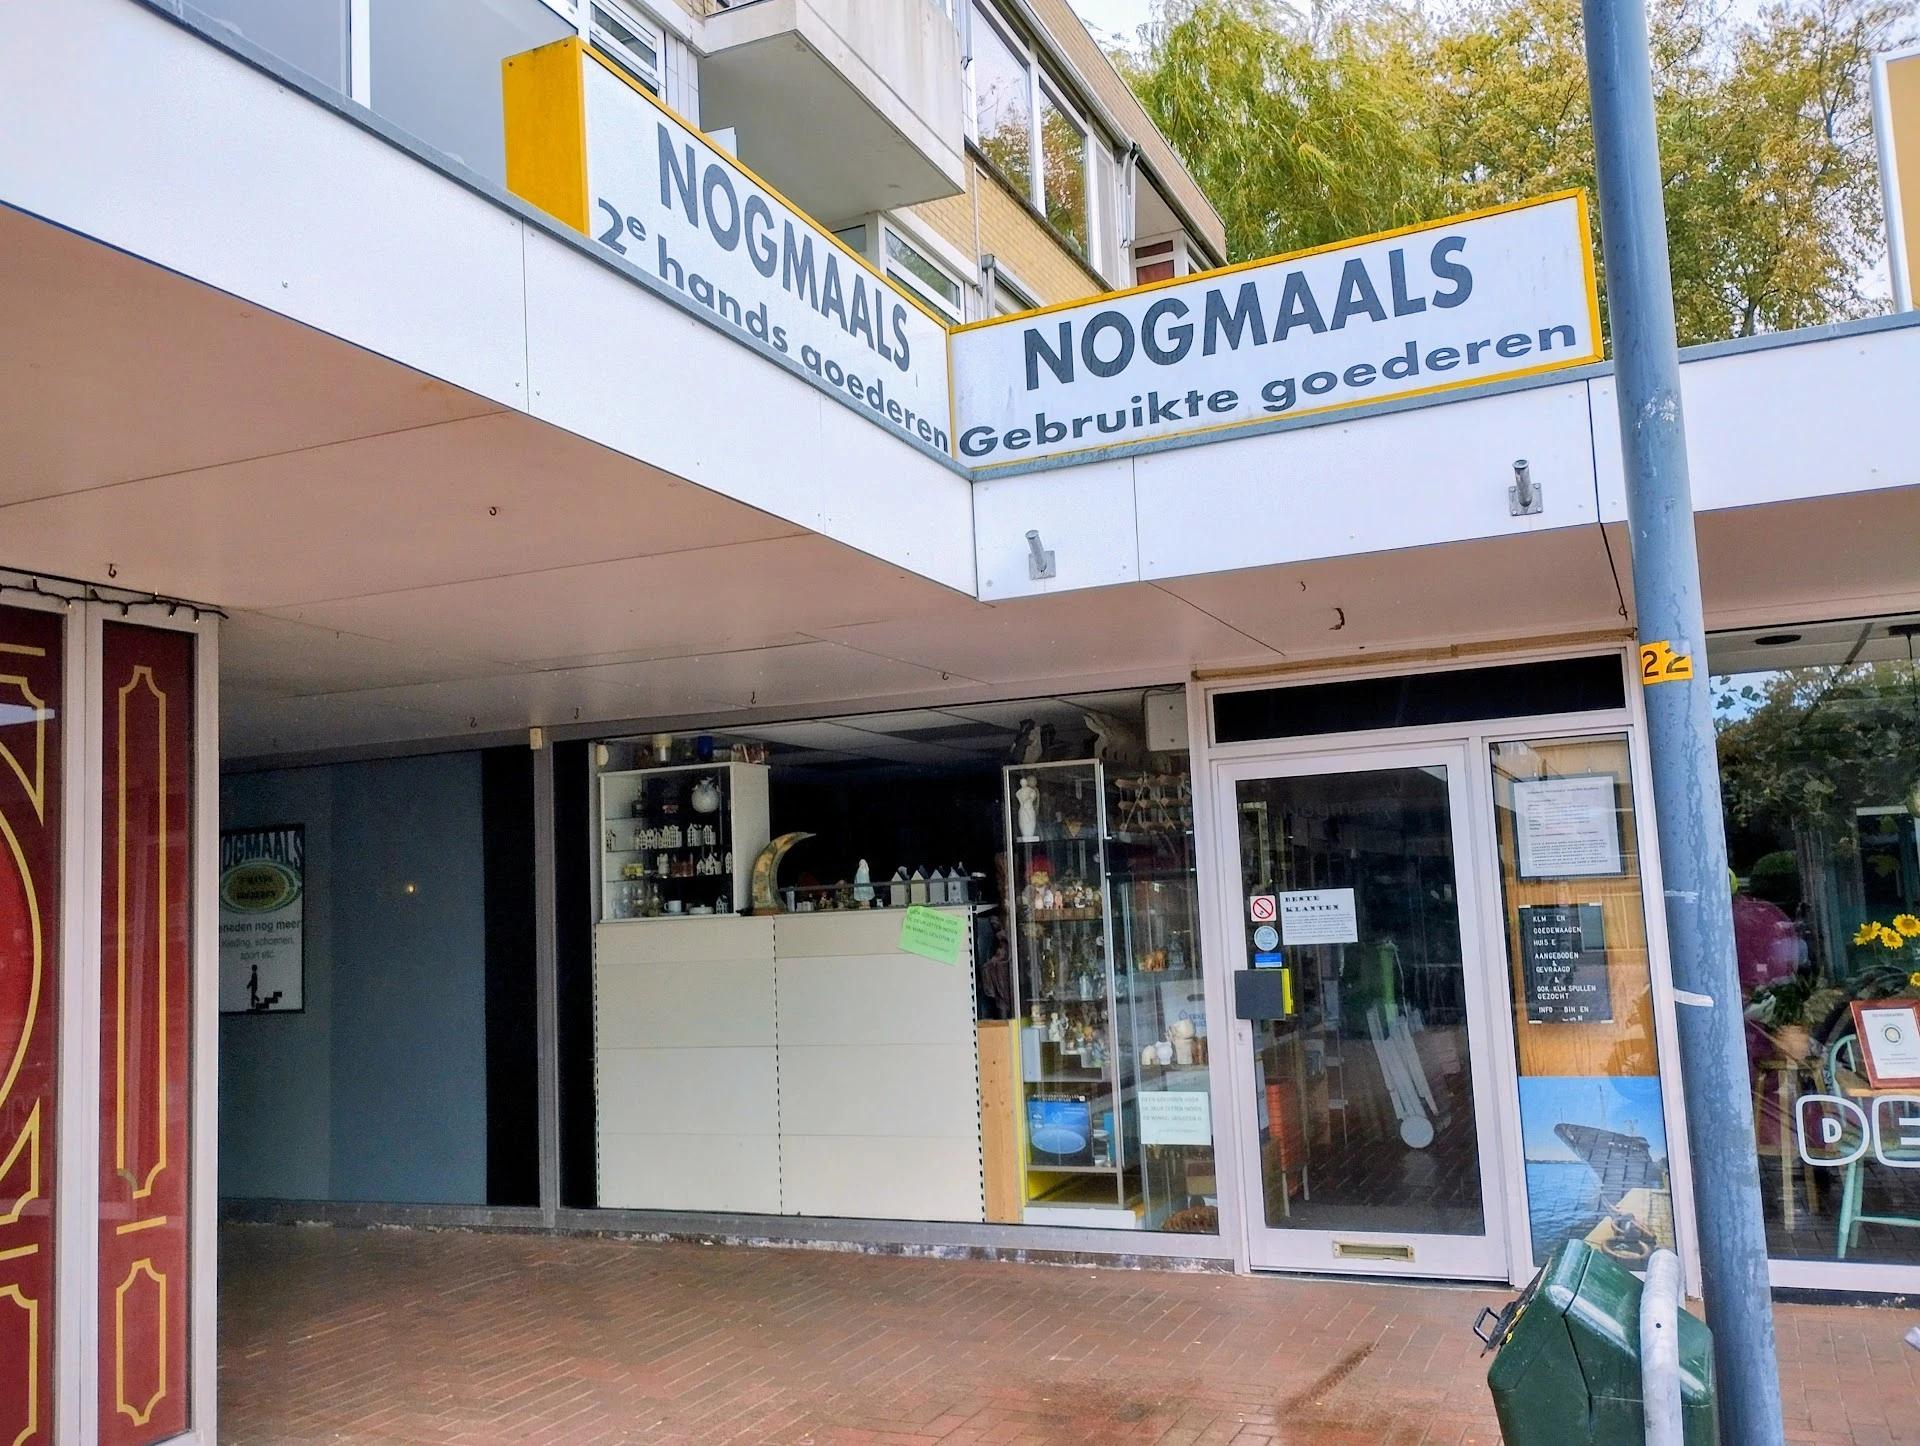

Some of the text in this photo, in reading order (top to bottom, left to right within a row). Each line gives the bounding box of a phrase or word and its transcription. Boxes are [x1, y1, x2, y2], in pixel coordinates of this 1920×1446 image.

[656, 121, 911, 373] NOGMAALS
[597, 198, 647, 256] 2e
[657, 235, 789, 354] hands
[1023, 236, 1474, 391] NOGMAALS
[958, 323, 1577, 458] Gebruikte goederen
[219, 828, 303, 872] OGMAALS
[1284, 895, 1320, 903] BESTE
[1285, 904, 1340, 913] KLANTEN
[1532, 914, 1566, 923] KLM EN
[255, 922, 274, 933] nog
[276, 920, 300, 930] meer
[1533, 926, 1582, 935] GOEDEWAAGEN
[1534, 952, 1579, 960] AANGEBODEN
[1535, 966, 1571, 974] GEVRAAGD
[1554, 976, 1560, 984] &
[1553, 985, 1567, 993] KLM
[1568, 984, 1597, 992] SPULLEN
[1537, 992, 1570, 1000] GEZOCHT
